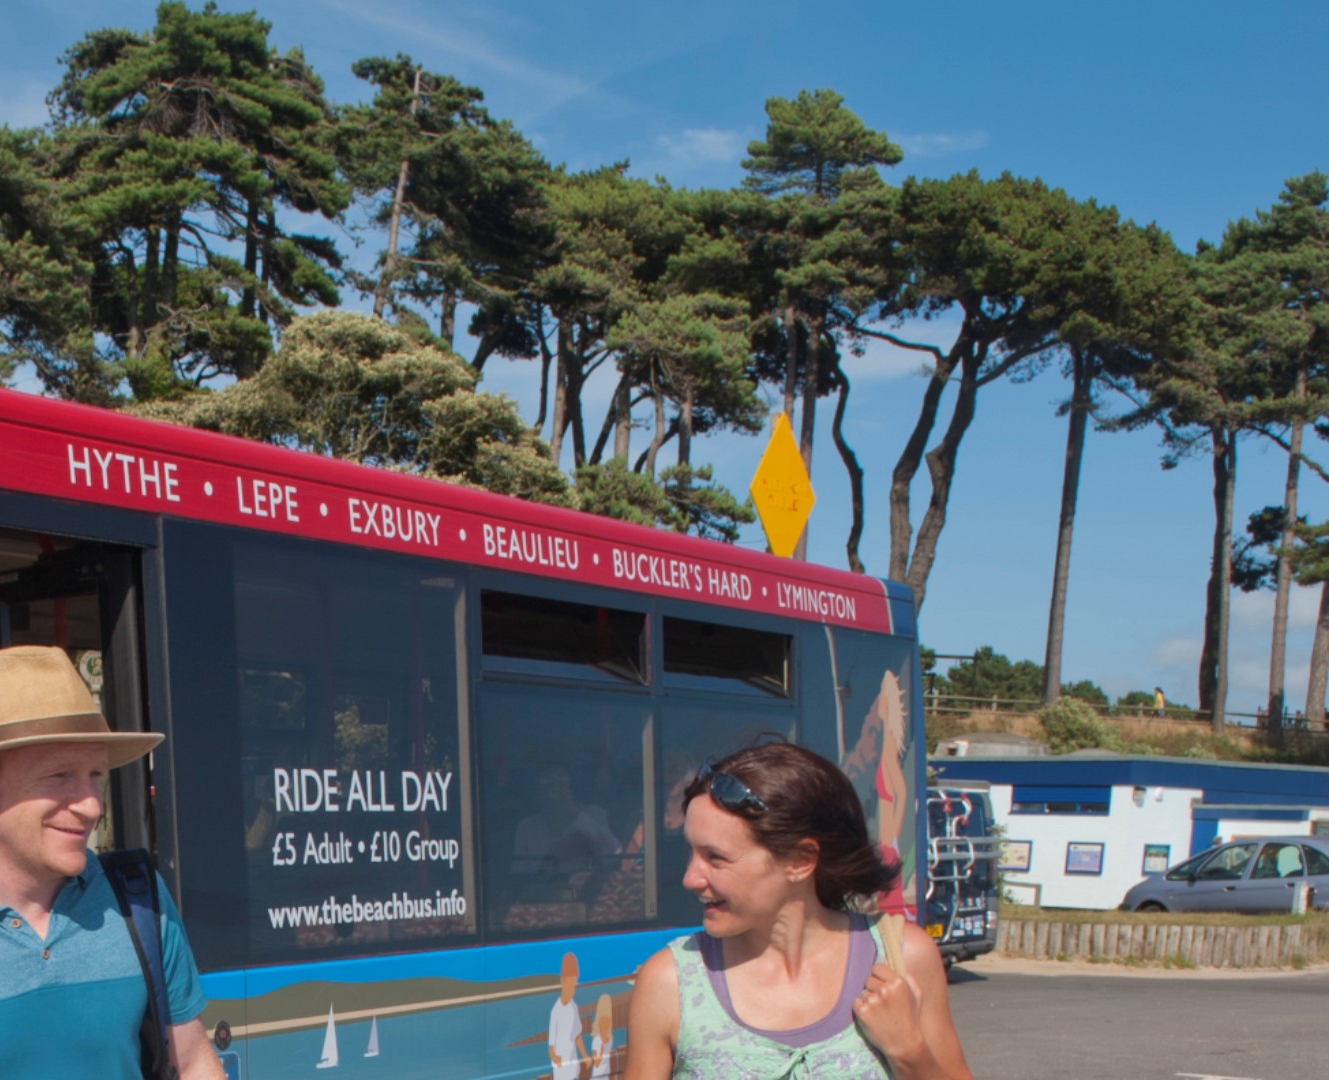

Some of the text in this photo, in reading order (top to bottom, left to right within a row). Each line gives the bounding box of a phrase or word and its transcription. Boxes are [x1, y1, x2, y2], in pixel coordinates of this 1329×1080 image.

[67, 444, 856, 621] HYTHE LEPE EXBURY BEAULIEU BUCKLER'S HARD LYMINGTON
[274, 768, 452, 812] RIDE ALL DAY
[272, 830, 459, 869] £5 Adult £10 Group
[268, 889, 466, 929] www.thebeachbus.info
